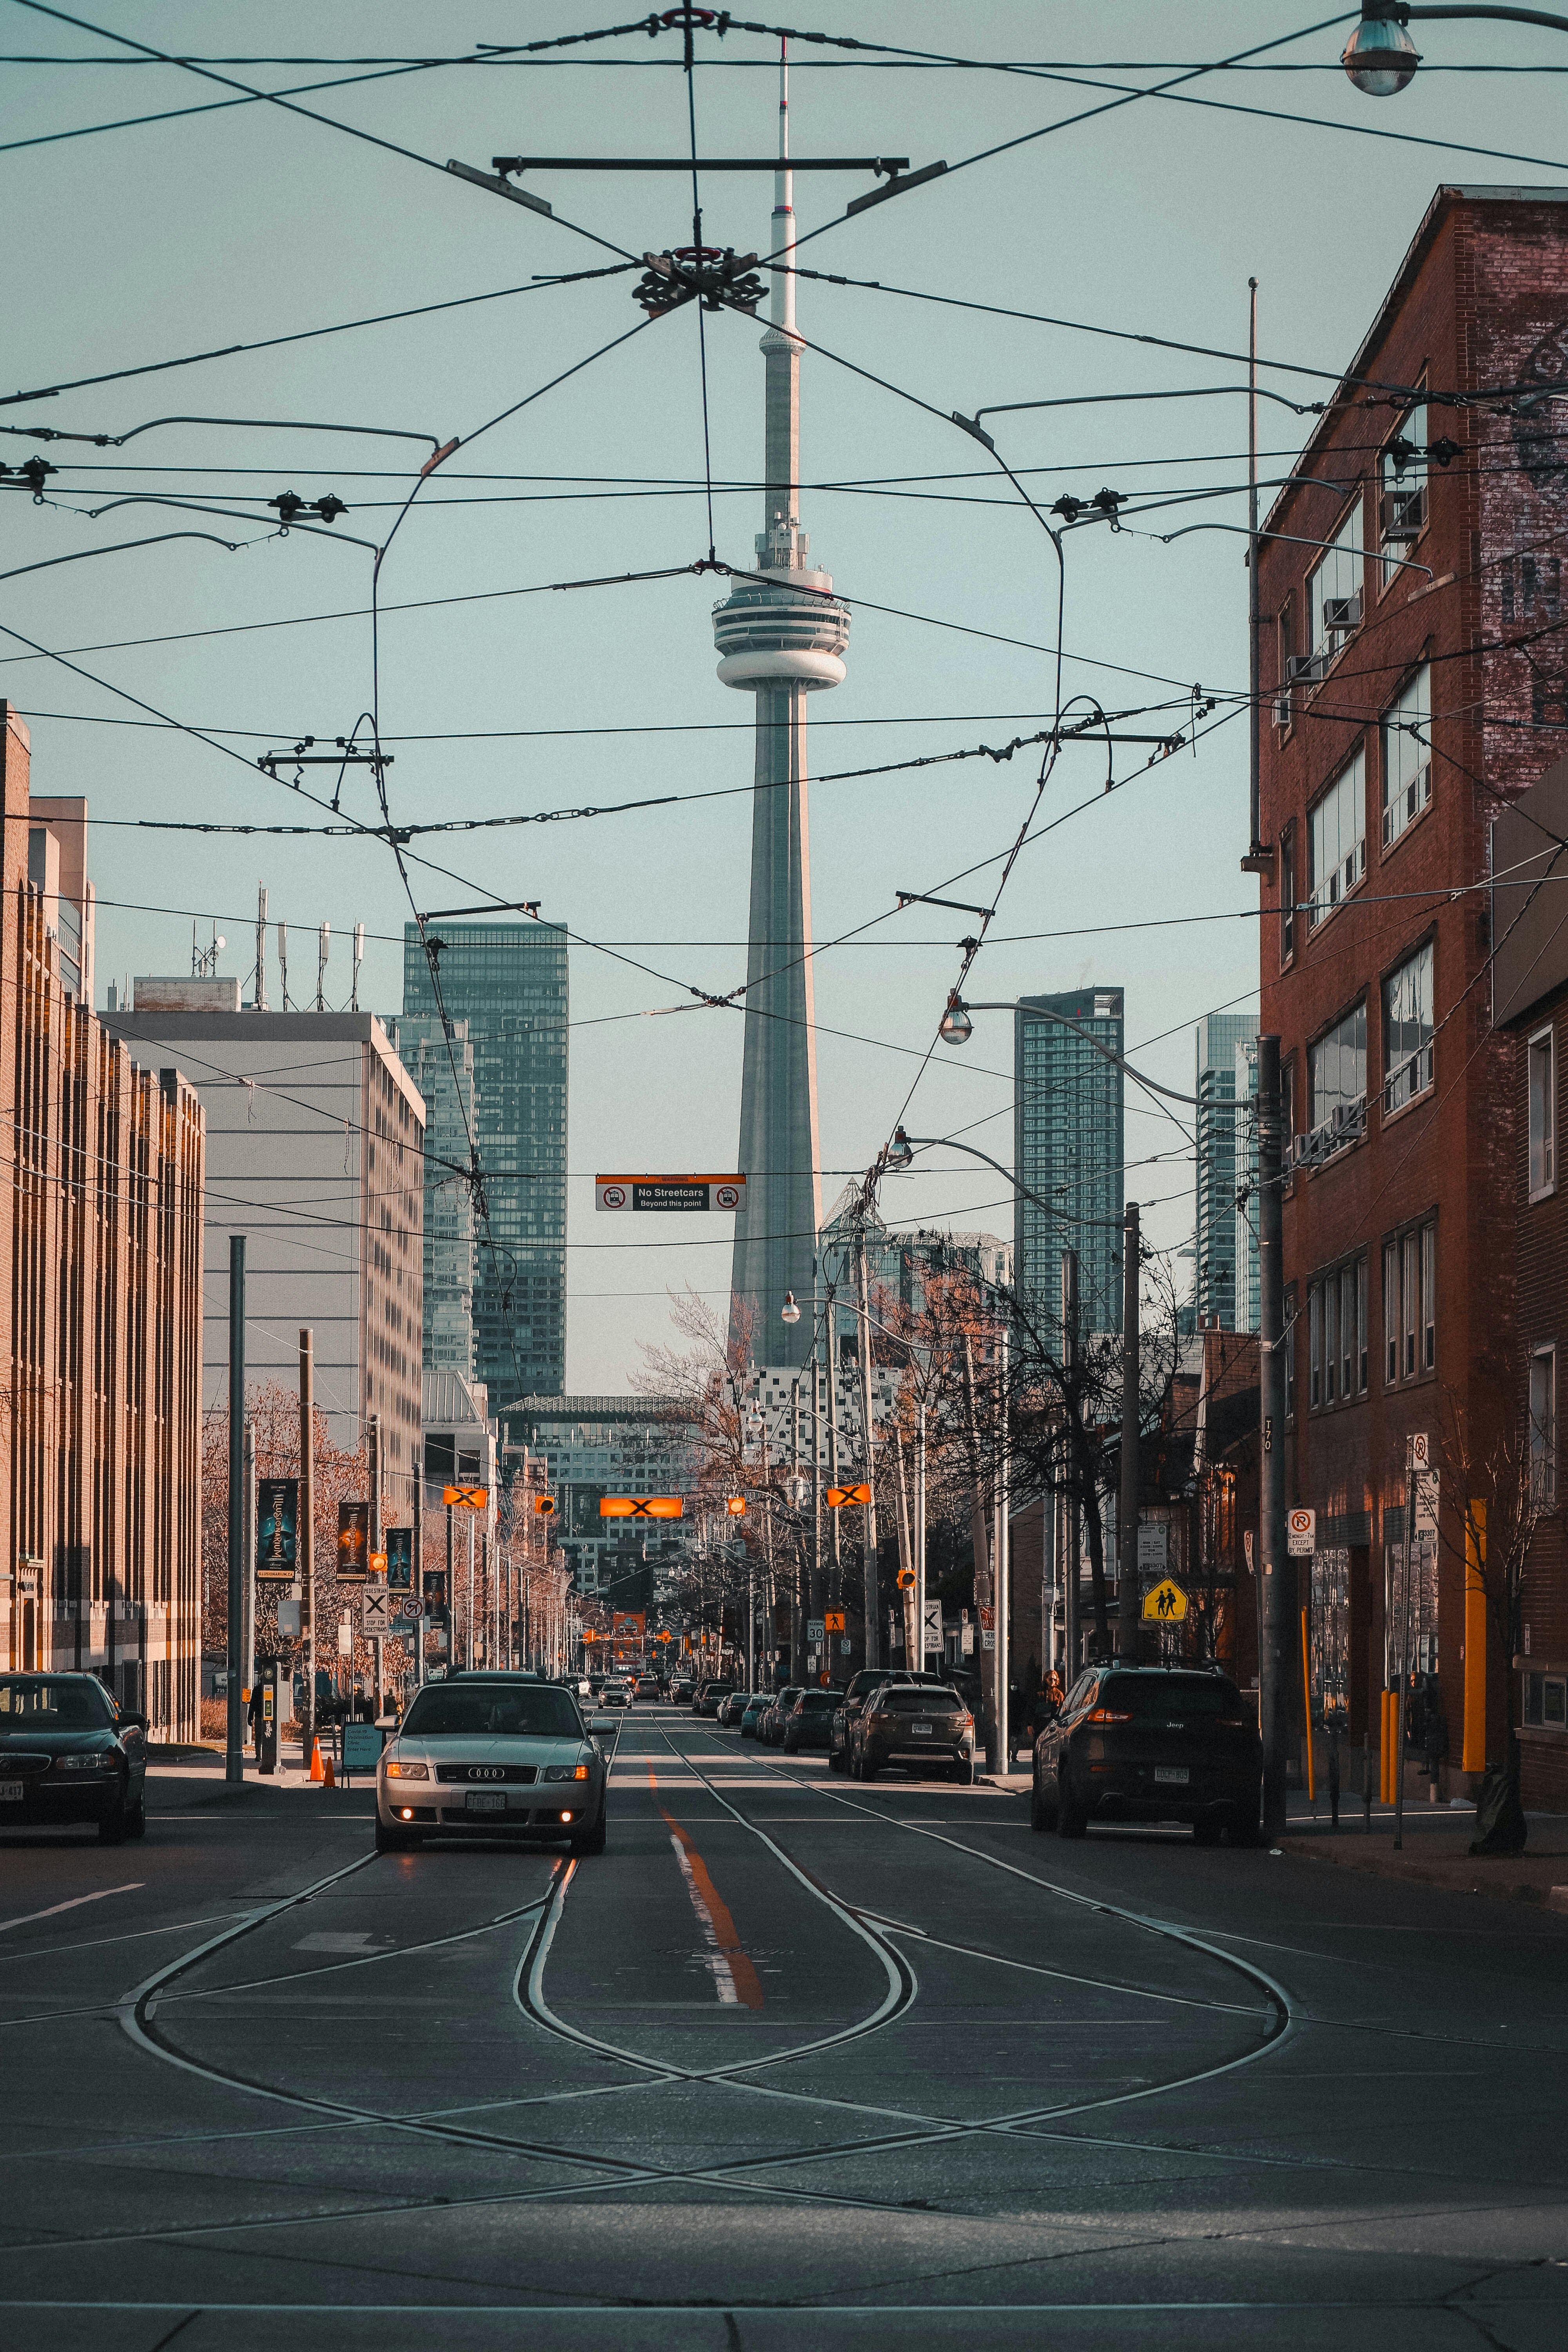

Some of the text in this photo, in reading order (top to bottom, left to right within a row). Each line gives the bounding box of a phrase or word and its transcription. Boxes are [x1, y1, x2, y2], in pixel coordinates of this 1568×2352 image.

[654, 1188, 704, 1196] Streetcars
[272, 1498, 284, 1557] ILLUSIONARIUM
[809, 1628, 823, 1638] 30
